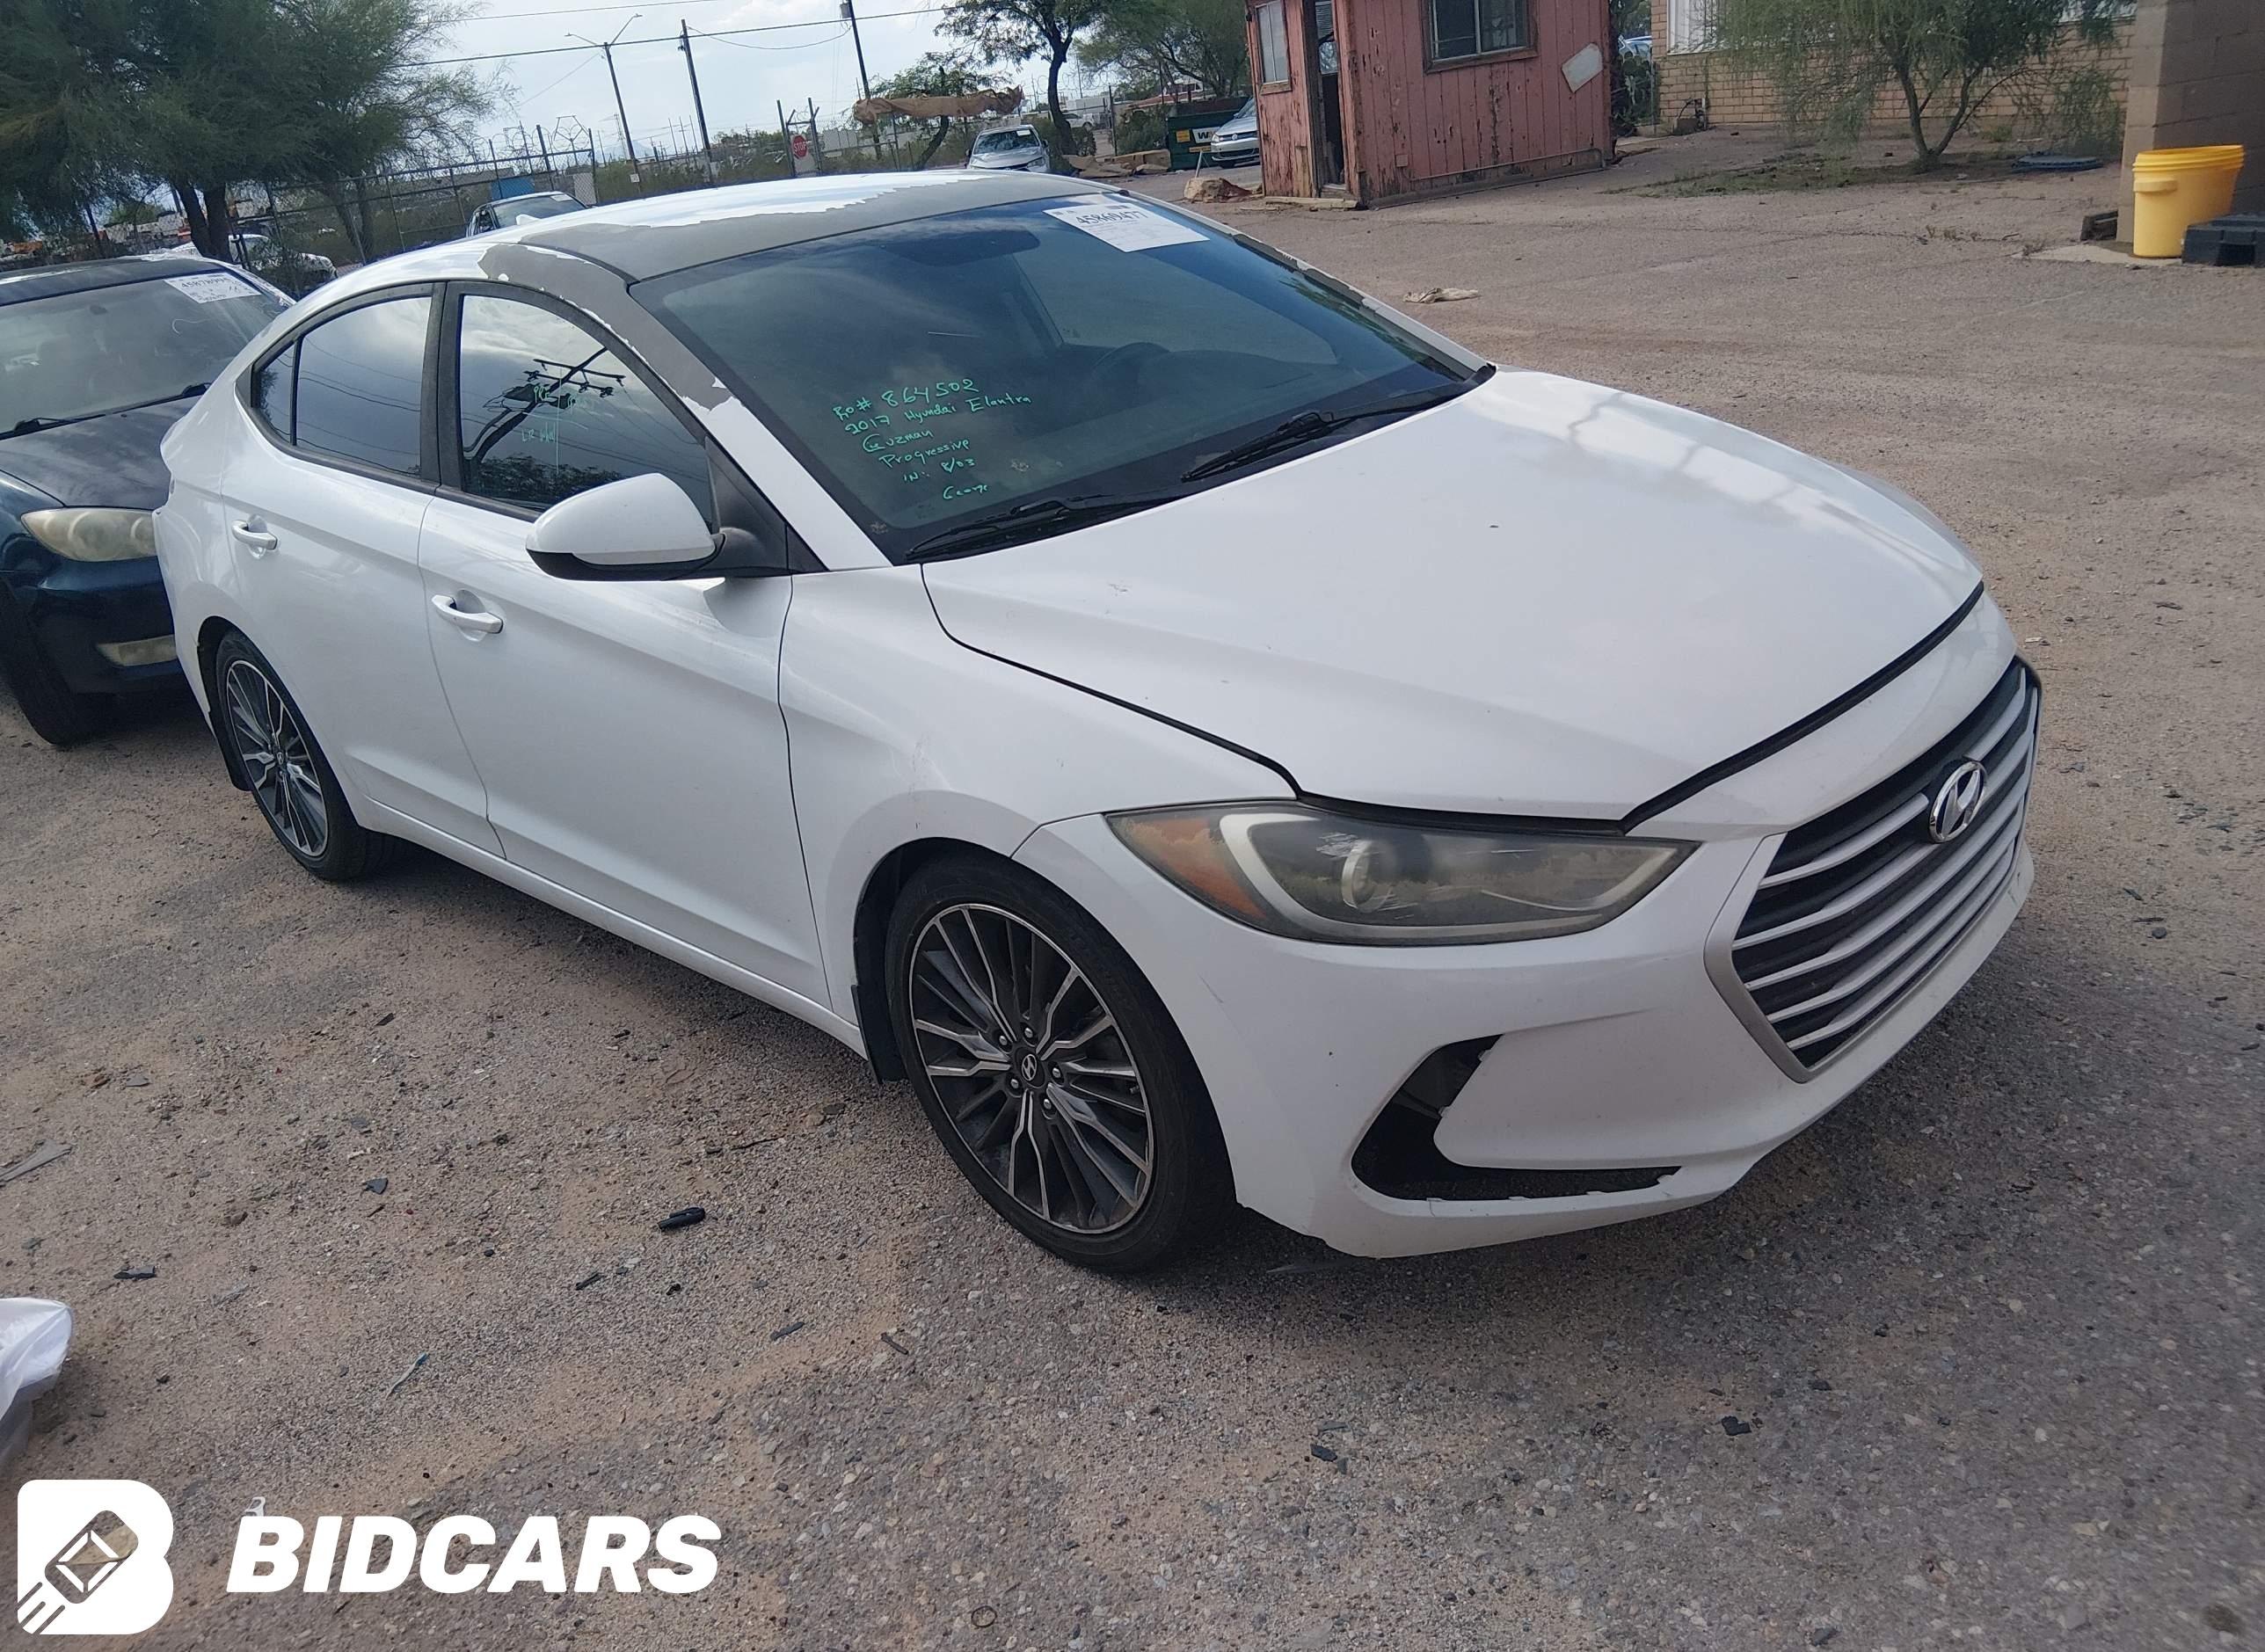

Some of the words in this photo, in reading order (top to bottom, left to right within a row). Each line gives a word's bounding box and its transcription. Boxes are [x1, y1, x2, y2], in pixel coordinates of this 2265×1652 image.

[793, 141, 807, 152] STOP
[1075, 210, 1148, 224] 45869477
[881, 379, 980, 407] 864502
[845, 415, 891, 435] 2017
[904, 404, 957, 424] Hyundai
[965, 392, 1032, 412] Elantra
[862, 430, 934, 453] Guzman
[878, 439, 970, 469] Progressive
